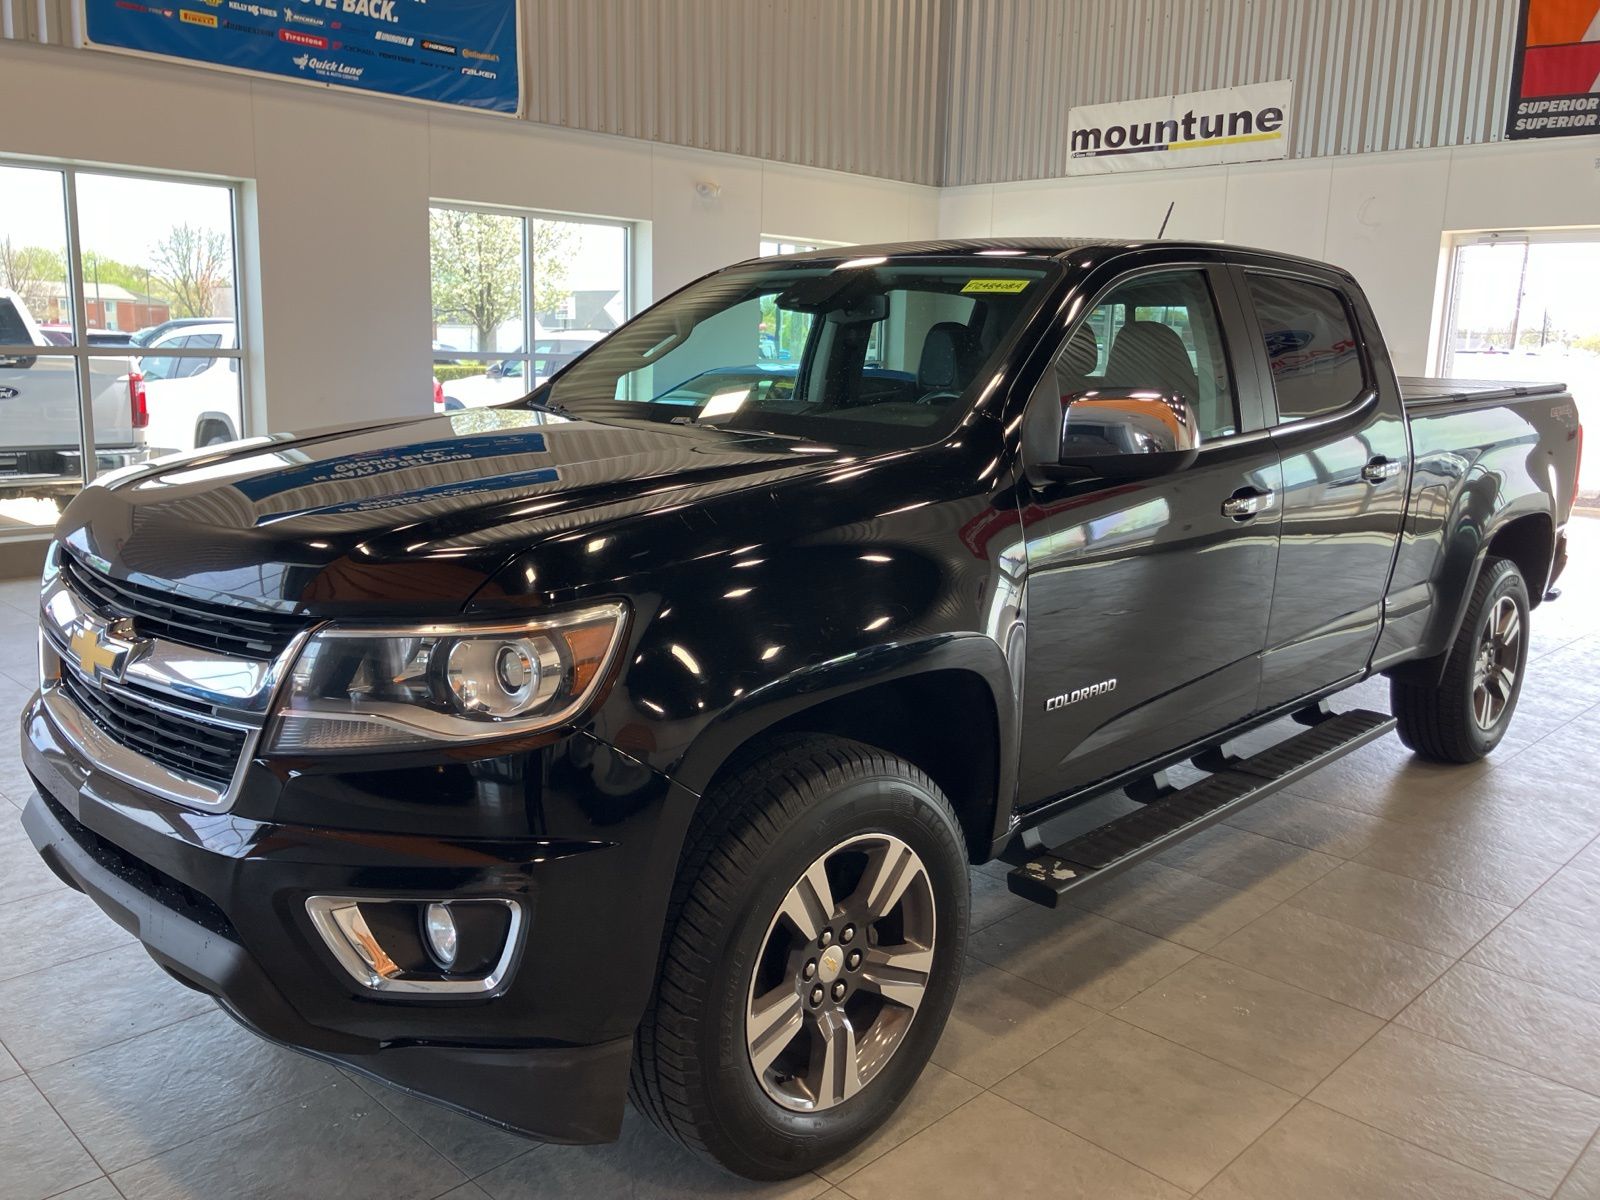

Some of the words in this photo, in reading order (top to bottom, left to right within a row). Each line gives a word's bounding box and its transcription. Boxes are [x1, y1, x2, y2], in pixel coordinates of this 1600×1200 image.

[228, 1, 249, 12] KELLY
[259, 7, 278, 17] TIRES
[293, 14, 324, 26] MICHELIN
[284, 32, 323, 47] Firestone
[308, 58, 338, 71] Quick
[338, 63, 364, 76] Lane
[461, 66, 497, 80] FALKEN
[1517, 97, 1600, 115] SUPERIOR
[1071, 107, 1283, 152] mountune
[1514, 114, 1598, 131] SUPERIOR
[1045, 678, 1117, 712] COLORADO
